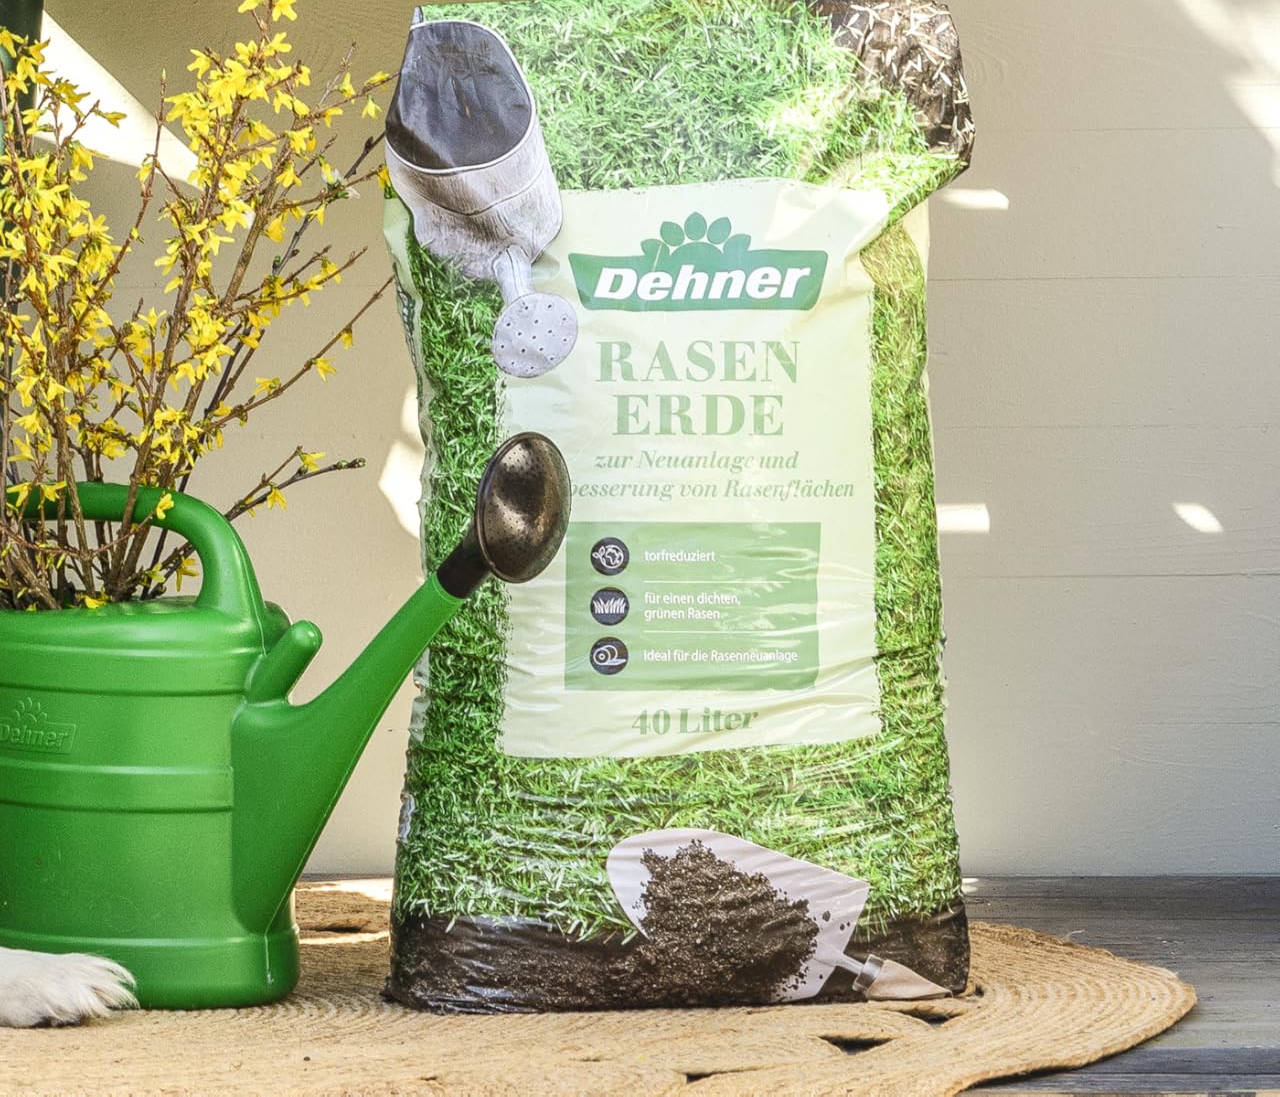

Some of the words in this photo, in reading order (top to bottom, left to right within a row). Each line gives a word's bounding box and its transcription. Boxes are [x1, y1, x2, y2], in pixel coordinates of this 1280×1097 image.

[594, 265, 811, 301] Dehner
[595, 340, 800, 383] RASEN
[612, 394, 784, 435] ERDE
[595, 454, 634, 469] zur
[638, 450, 754, 473] Neuanlage
[759, 450, 799, 469] und
[680, 484, 717, 497] von
[723, 479, 854, 501] Rasenflächen
[644, 550, 716, 562] torfreduziert
[644, 592, 660, 604] für
[663, 592, 694, 604] einen
[697, 591, 741, 606] dichten,
[644, 608, 685, 622] grünen
[688, 608, 720, 619] Rasen
[673, 649, 690, 661] für
[693, 649, 708, 661] die
[711, 650, 797, 663] Rasenneuanlage
[631, 709, 671, 735] 40
[678, 706, 759, 734] Liter
